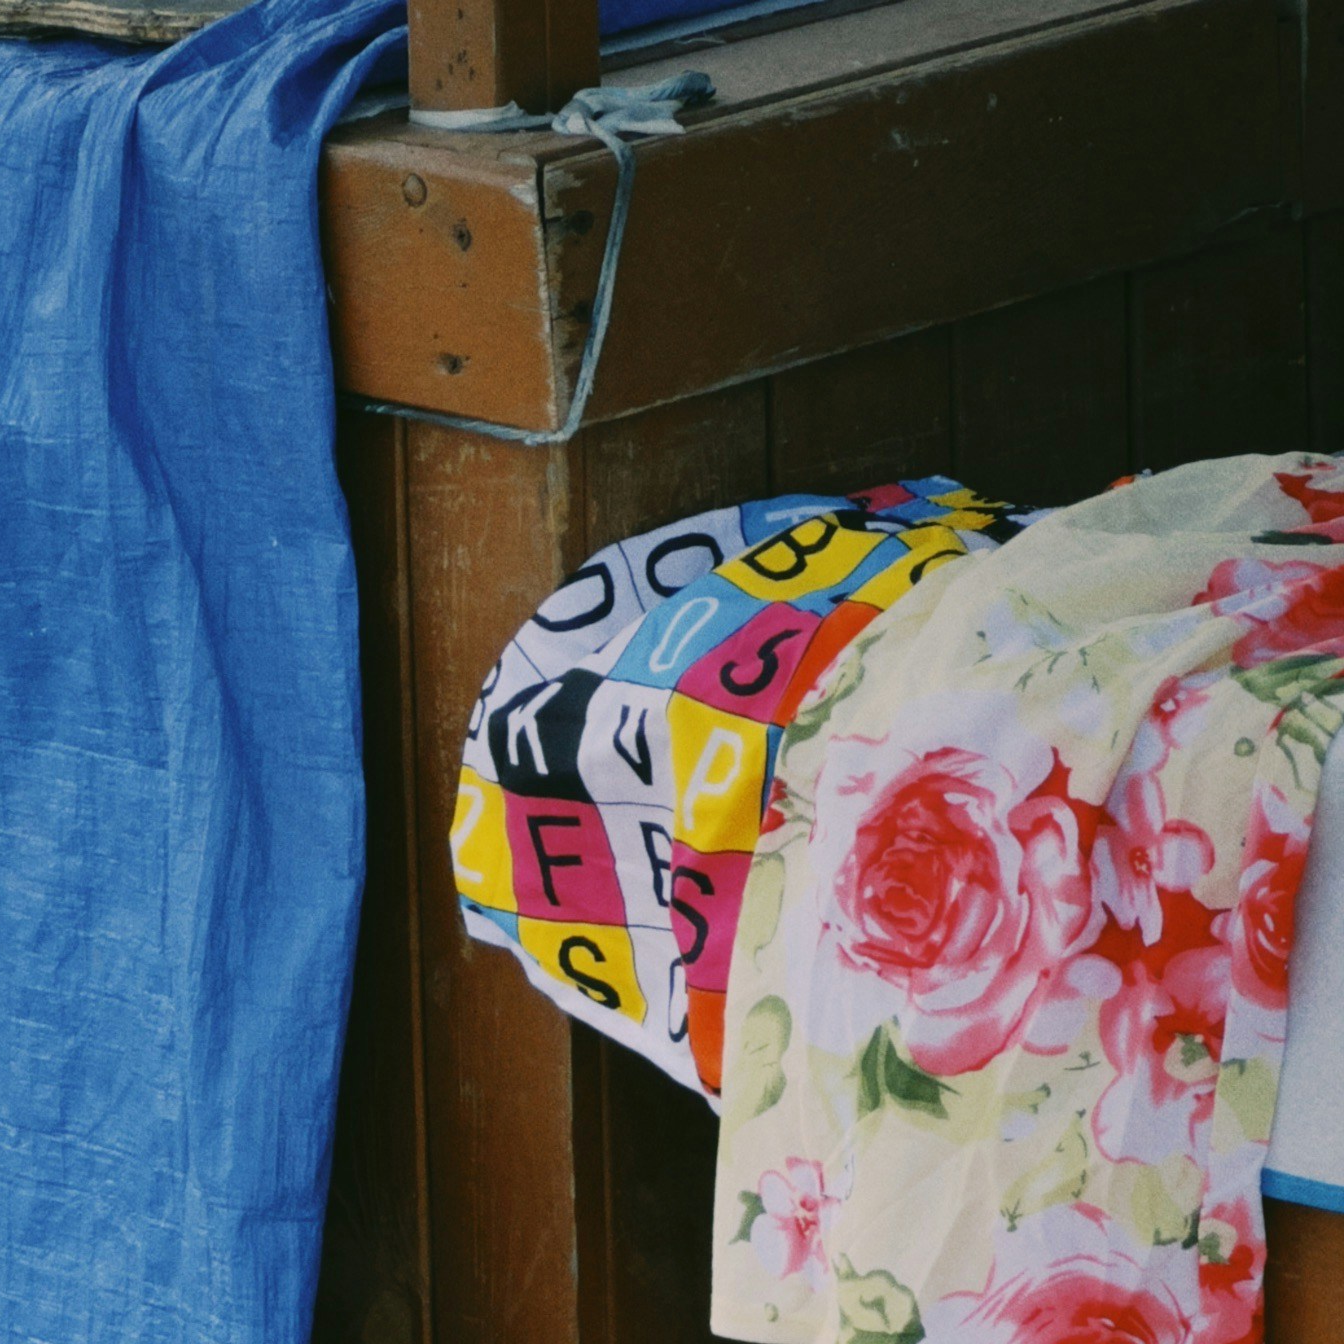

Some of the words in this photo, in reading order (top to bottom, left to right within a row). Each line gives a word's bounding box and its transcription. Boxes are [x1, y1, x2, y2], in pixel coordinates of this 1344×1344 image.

[740, 515, 839, 582] B
[506, 680, 566, 776] K
[682, 727, 744, 832] P
[526, 815, 584, 907] F
[670, 866, 715, 966] S
[558, 935, 622, 1011] S
